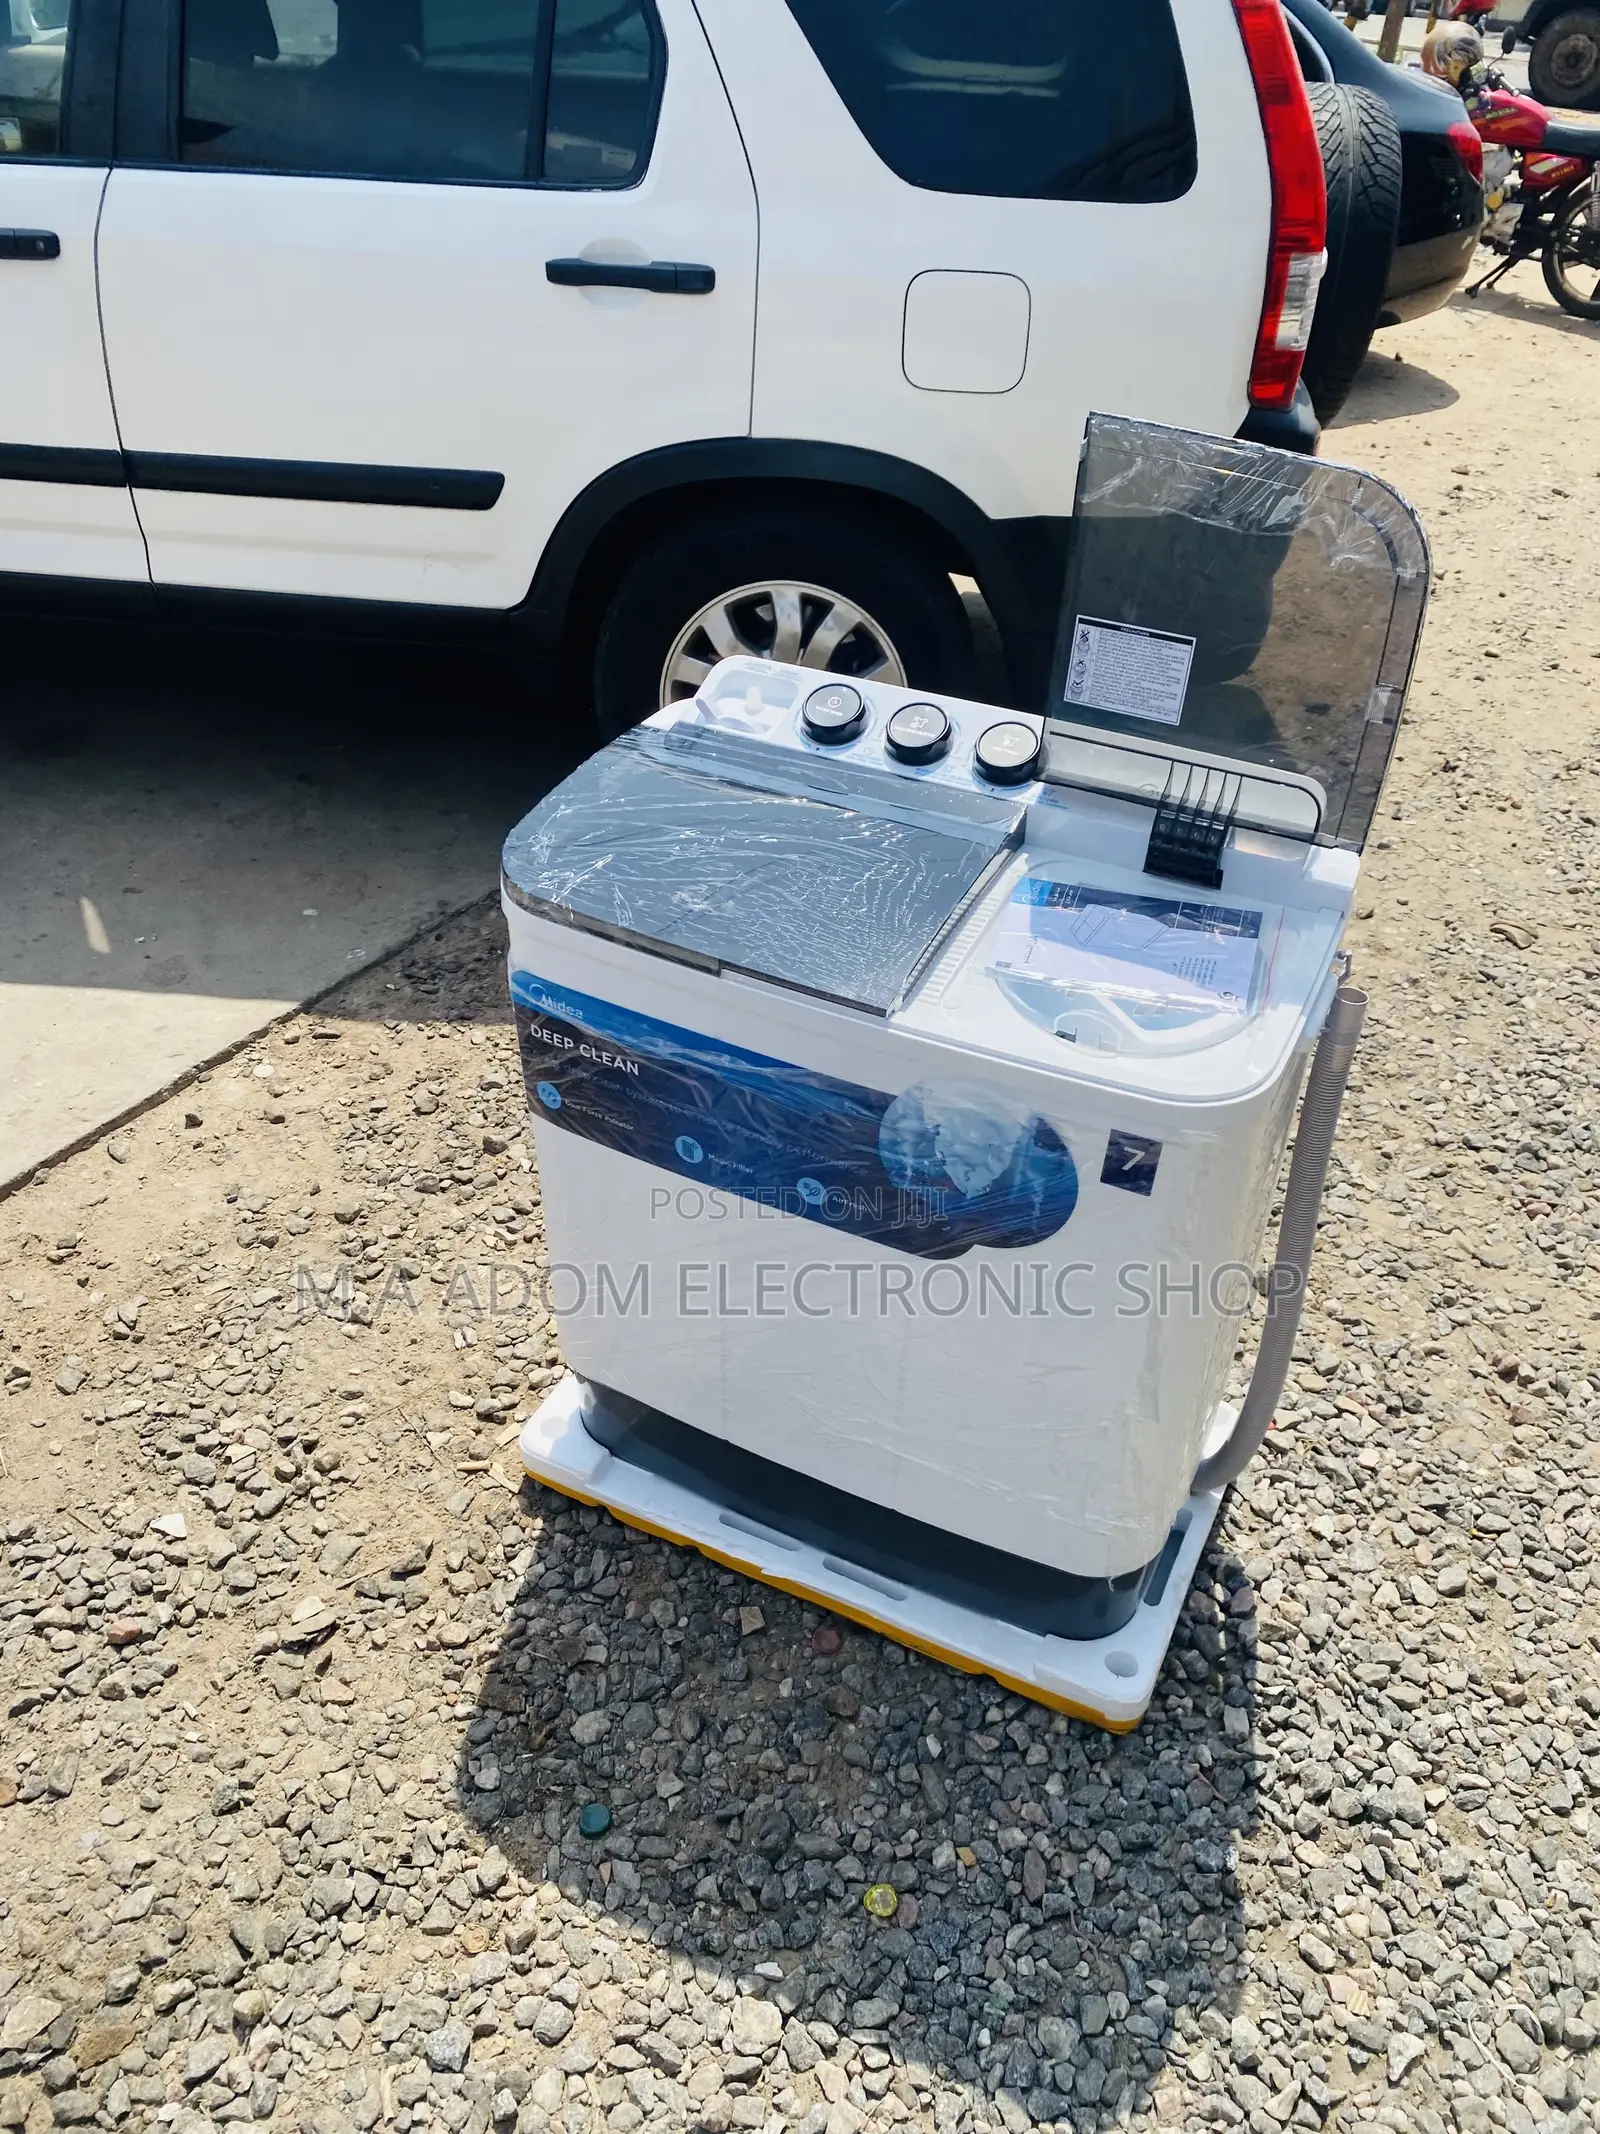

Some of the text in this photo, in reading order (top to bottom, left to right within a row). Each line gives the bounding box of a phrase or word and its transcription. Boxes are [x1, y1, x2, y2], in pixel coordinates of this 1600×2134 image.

[536, 990, 583, 1019] Midea
[530, 1024, 640, 1076] DEEP CLEAN
[583, 1106, 603, 1119] Force
[1122, 1146, 1146, 1171] 7
